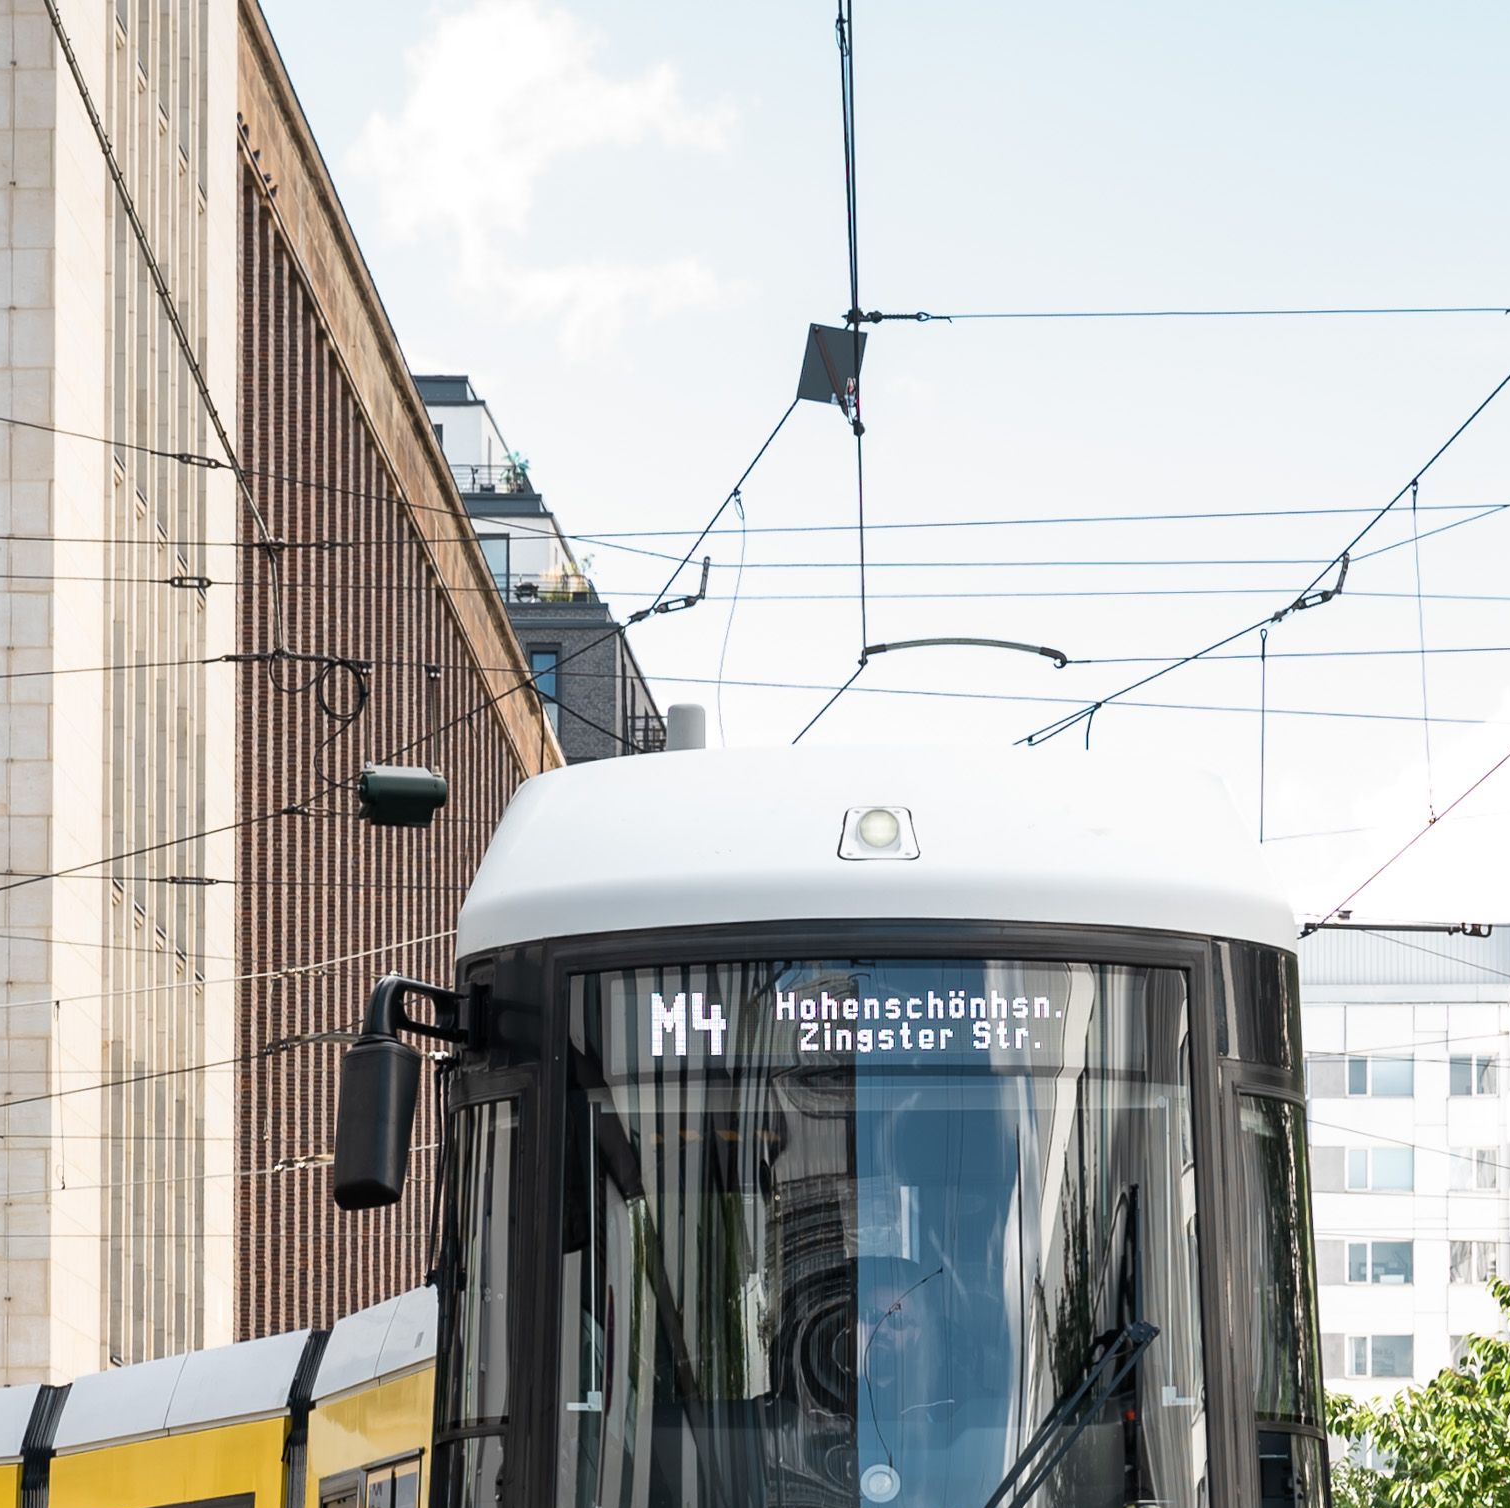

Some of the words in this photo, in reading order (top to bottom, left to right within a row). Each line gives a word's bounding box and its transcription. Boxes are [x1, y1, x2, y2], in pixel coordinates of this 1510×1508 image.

[775, 990, 1063, 1020] Hohenschönhsn.
[650, 992, 727, 1057] M4
[799, 1022, 954, 1053] Zingster
[972, 1021, 1042, 1051] Str.
